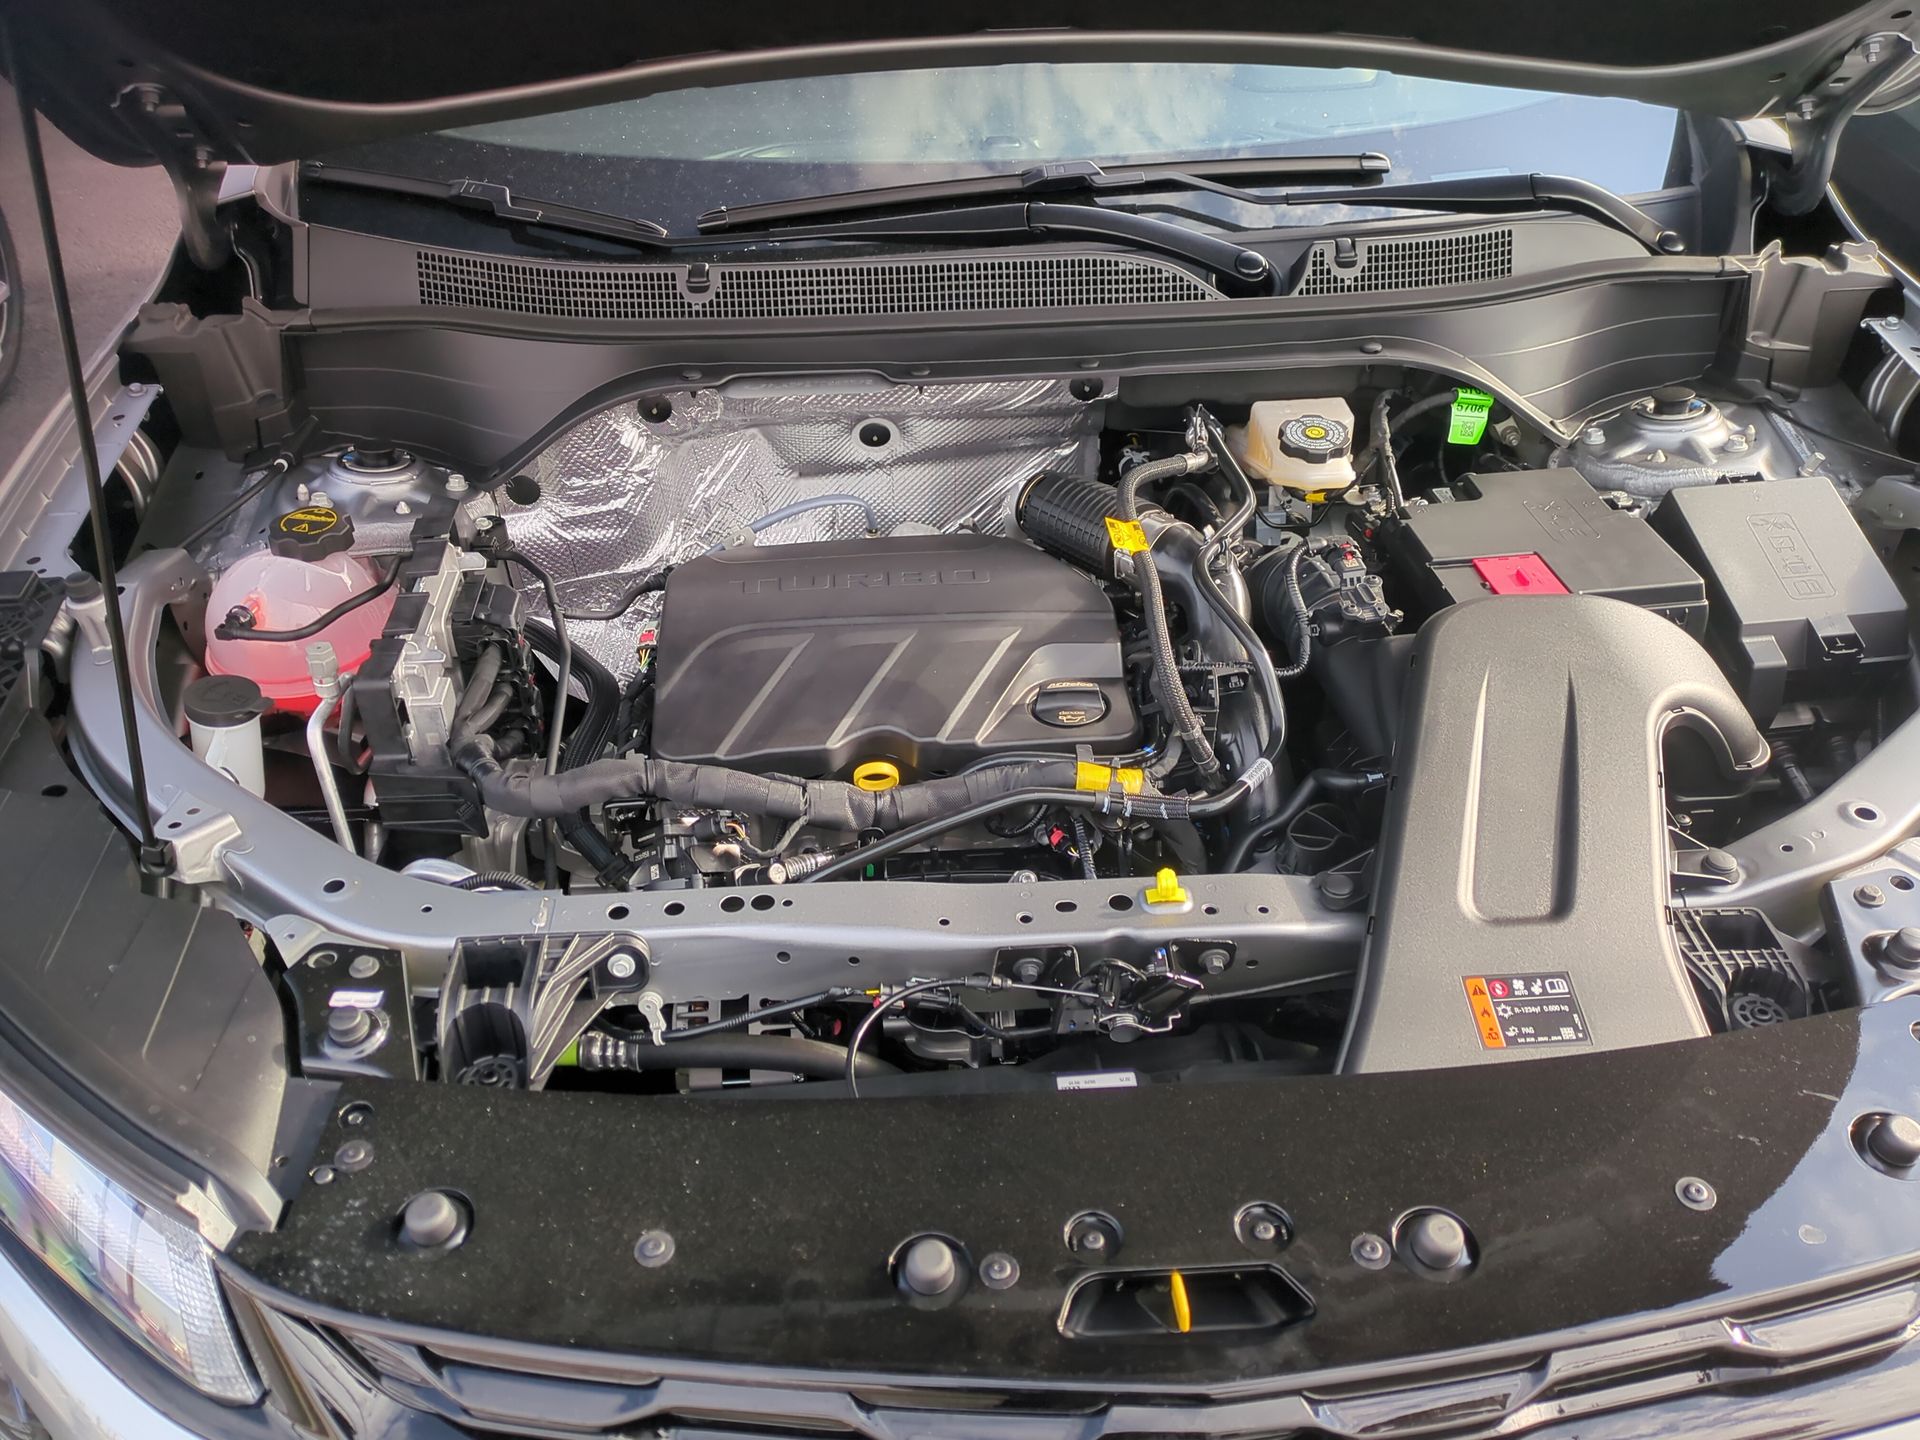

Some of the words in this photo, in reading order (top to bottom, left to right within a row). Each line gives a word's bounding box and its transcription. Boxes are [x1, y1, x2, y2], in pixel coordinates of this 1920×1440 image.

[1456, 403, 1484, 413] 5708
[728, 569, 992, 594] TURBO
[1514, 1006, 1541, 1015] R-1234yf
